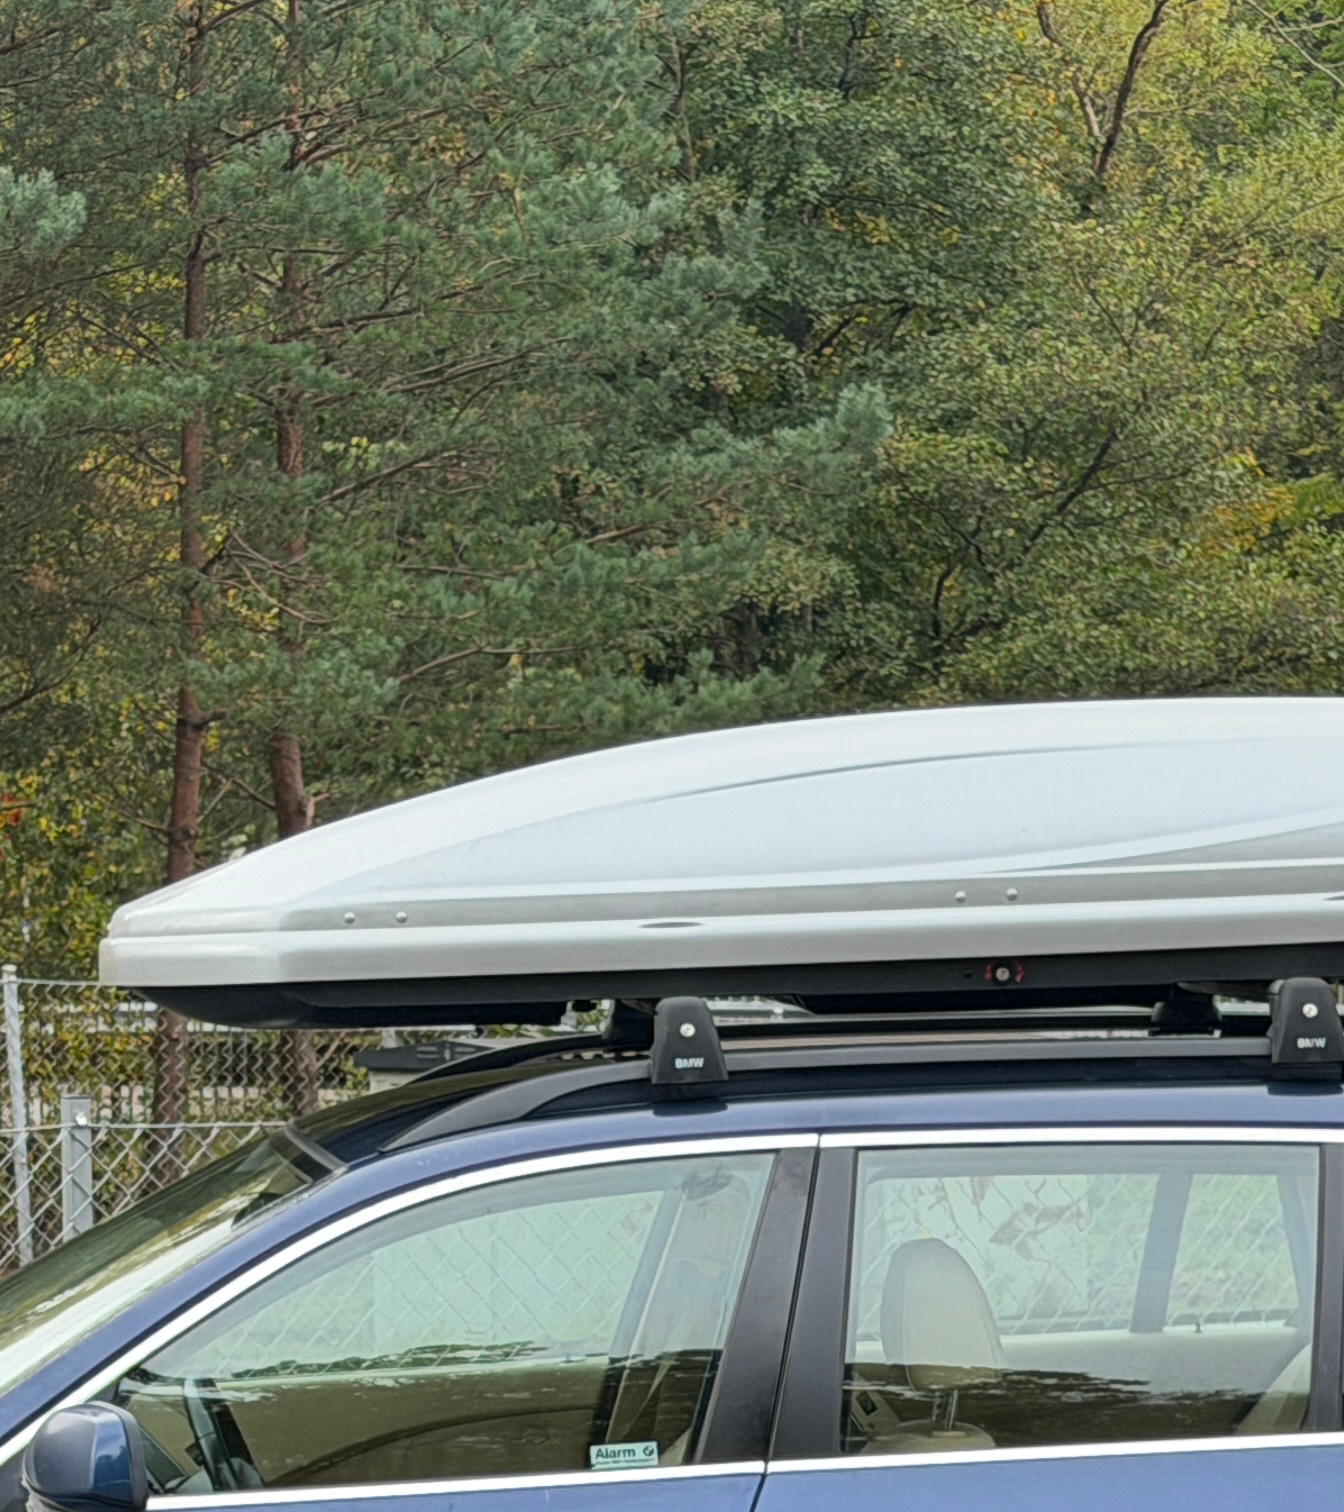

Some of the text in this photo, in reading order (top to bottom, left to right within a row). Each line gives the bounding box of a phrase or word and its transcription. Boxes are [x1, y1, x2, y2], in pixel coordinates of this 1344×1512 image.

[1296, 1037, 1327, 1049] BMW
[674, 1057, 705, 1069] BMW
[594, 1447, 636, 1460] Alarm
